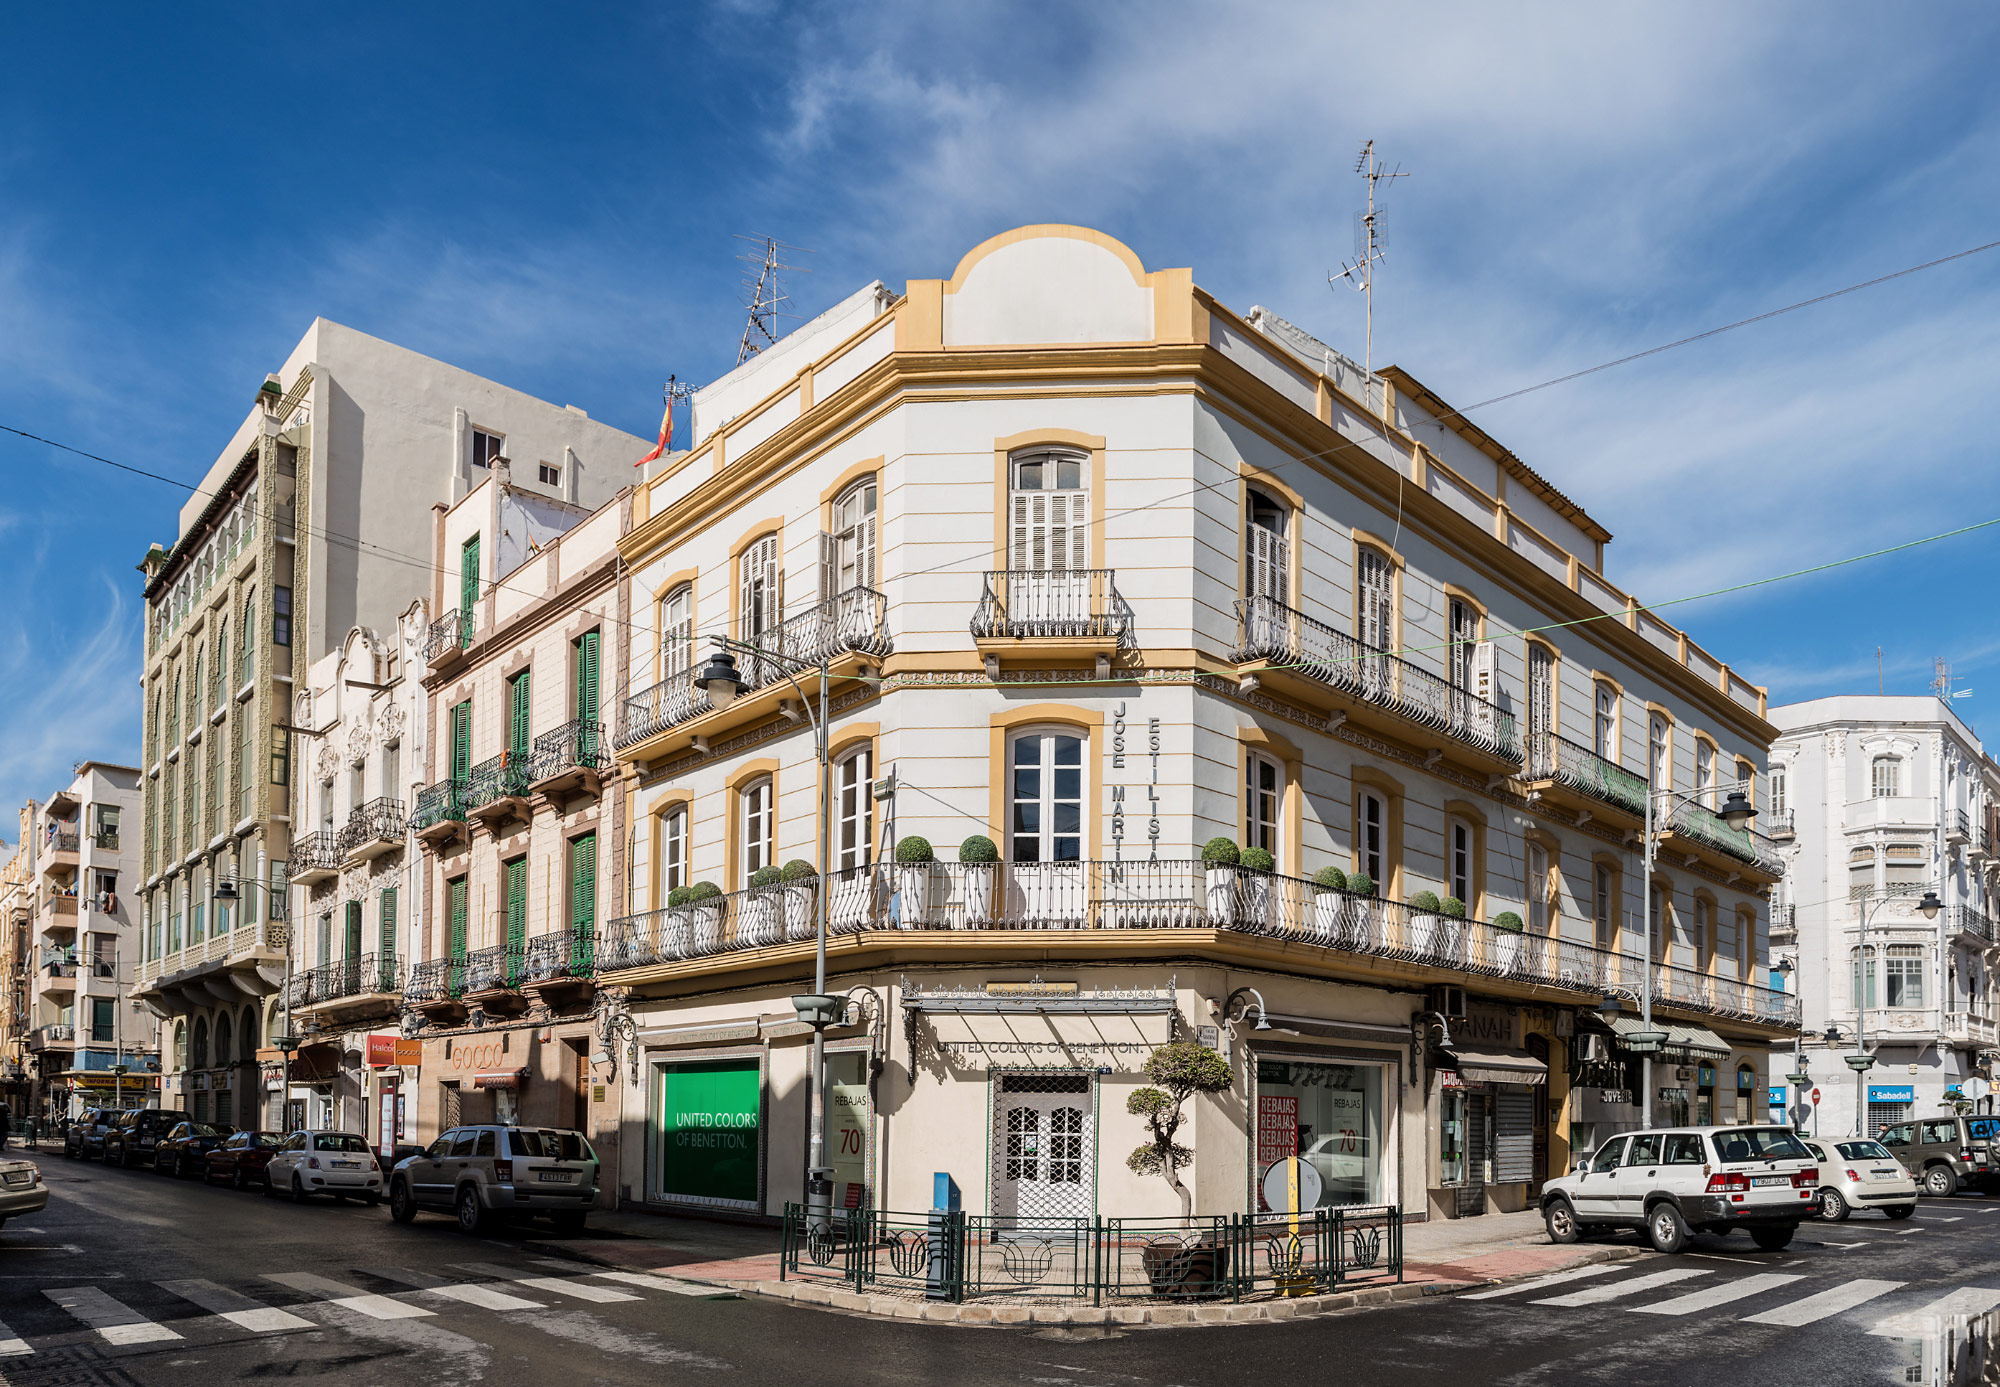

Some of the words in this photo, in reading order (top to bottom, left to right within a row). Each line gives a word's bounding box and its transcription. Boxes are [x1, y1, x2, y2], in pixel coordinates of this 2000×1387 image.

[1113, 701, 1126, 769] JOSE
[1148, 717, 1160, 868] ESTILISTA
[1111, 785, 1125, 884] MARTIN
[937, 1041, 984, 1054] UNITED
[988, 1042, 1043, 1054] COLORS
[1047, 1042, 1064, 1054] OF
[452, 1043, 503, 1070] GOCCO
[835, 1095, 867, 1106] REBAJAS
[1334, 1098, 1361, 1109] REBAJAS
[1604, 1090, 1632, 1103] JOYERIA
[1876, 1091, 1911, 1100] Sabadell
[1261, 1097, 1296, 1114] REBAJAS
[676, 1112, 713, 1127] UNITED
[714, 1112, 757, 1128] COLORS
[1260, 1113, 1296, 1130] REBAJAS
[676, 1132, 689, 1147] OF
[1260, 1129, 1295, 1146] REBAJAS
[1260, 1146, 1295, 1162] REBAJAS
